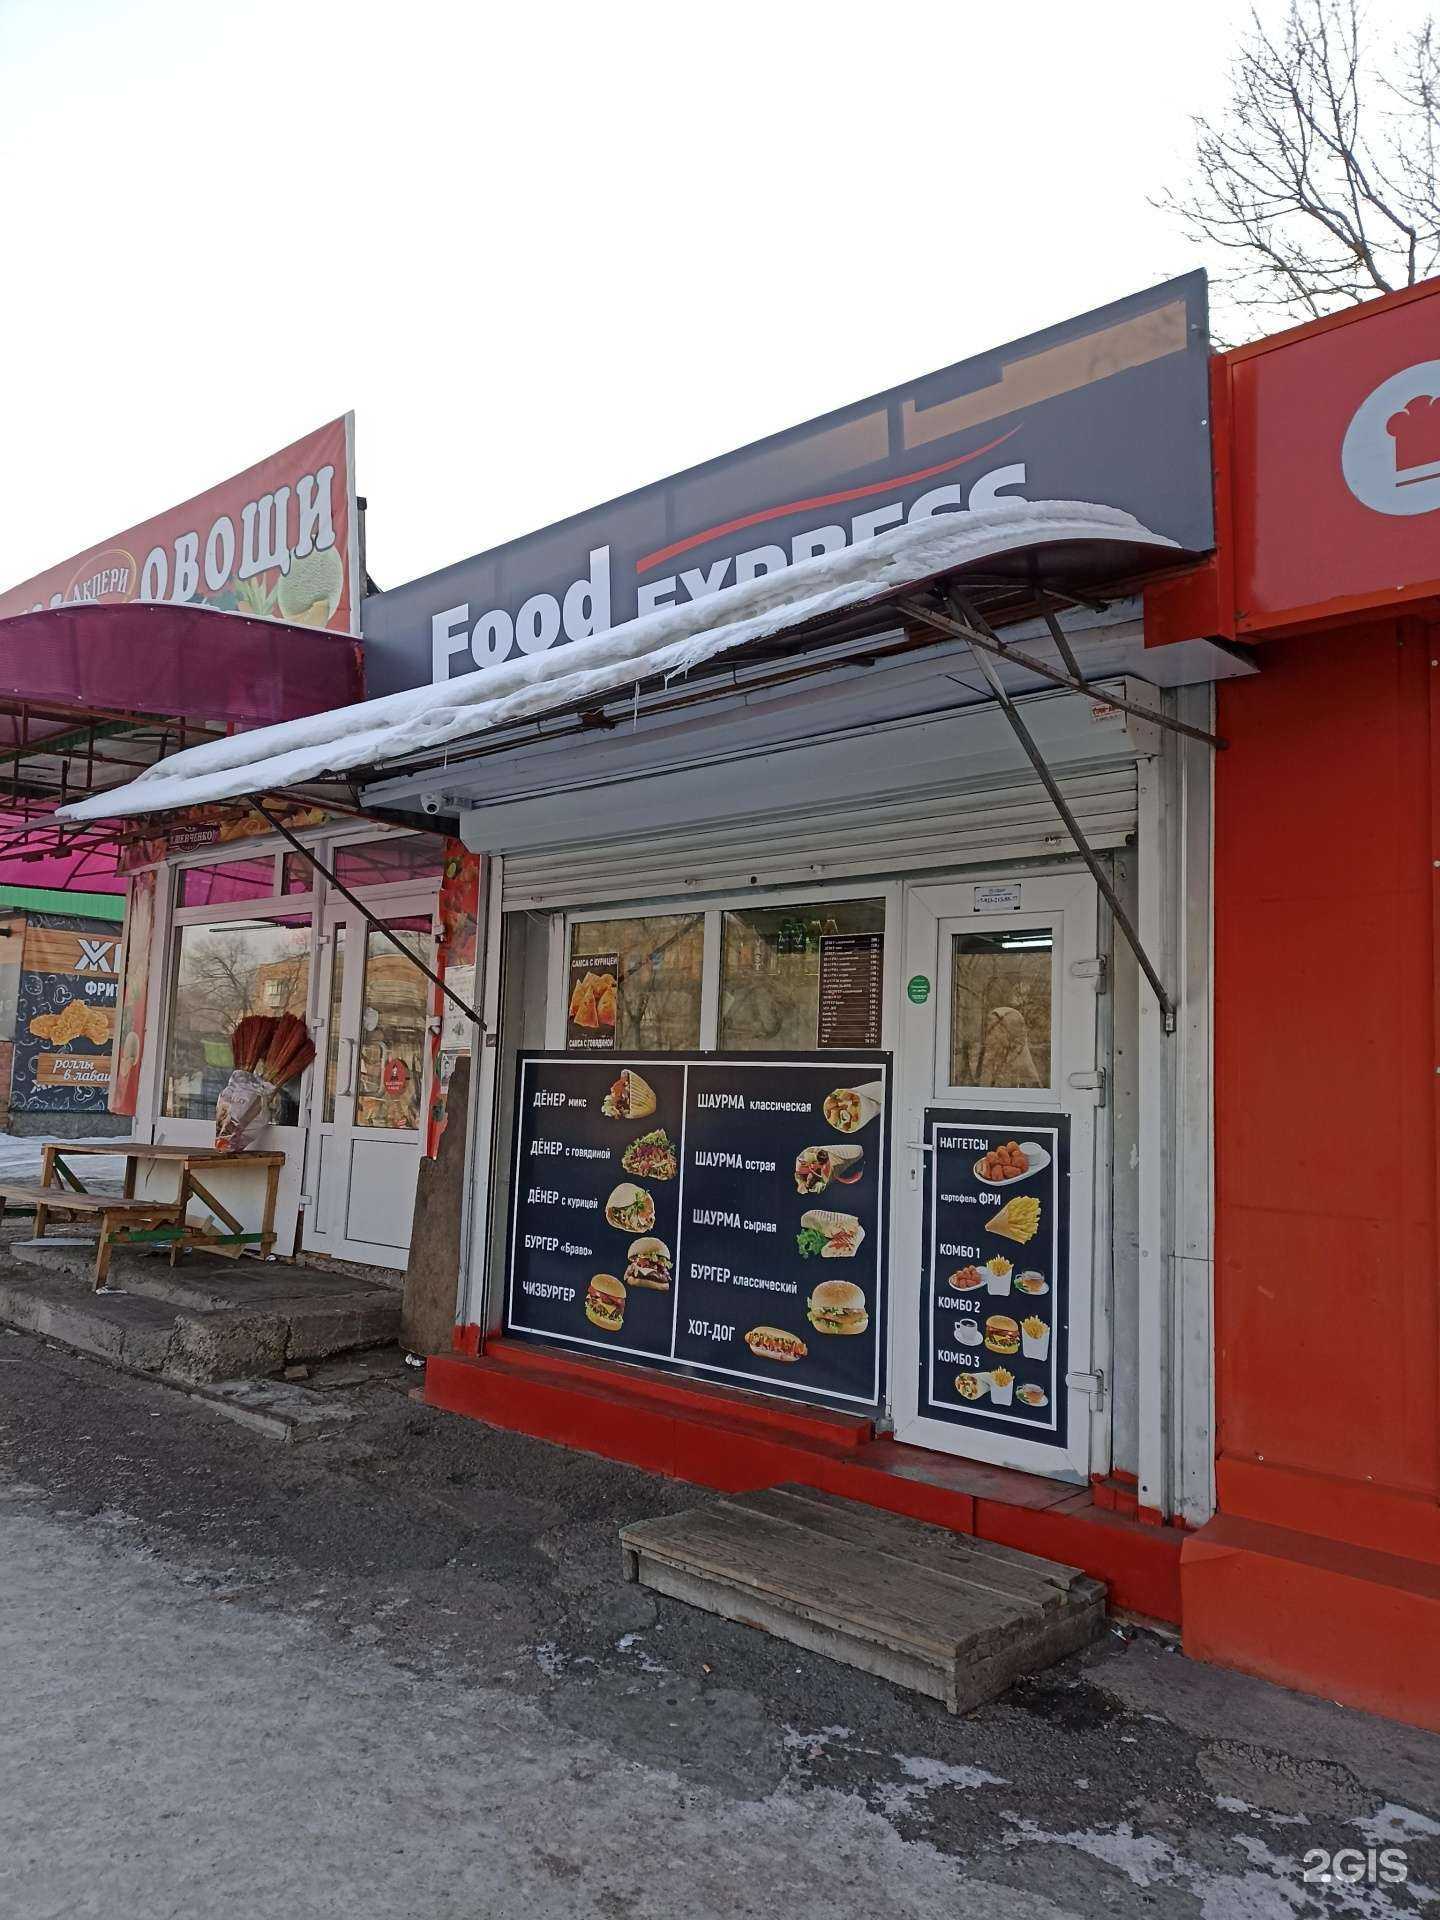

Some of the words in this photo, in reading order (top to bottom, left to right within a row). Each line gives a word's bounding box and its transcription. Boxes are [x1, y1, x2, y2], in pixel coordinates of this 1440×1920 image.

[140, 465, 336, 602] ОВОЩИ
[432, 545, 612, 684] Food
[53, 1058, 94, 1074] роллы
[63, 1069, 73, 1081] в
[533, 1089, 565, 1108] ДЁНЕР
[568, 1097, 587, 1108] микс
[697, 1093, 745, 1110] ШАУРМА
[750, 1100, 812, 1113] классическая
[530, 1138, 563, 1156] ДЁНЕР
[571, 1146, 611, 1160] говядиной
[939, 1136, 989, 1151] НАГГЕТСЫ
[695, 1151, 743, 1169] ШАУРМА
[745, 1160, 776, 1172] острая
[527, 1188, 559, 1204] ДЁНЕР
[567, 1197, 598, 1209] курицей
[940, 1193, 977, 1204] картофель
[978, 1191, 1001, 1206] ФРИ
[693, 1208, 741, 1229] ШАУРМА
[743, 1219, 777, 1233] сырная
[525, 1234, 559, 1253] БУРГЕР
[939, 1243, 974, 1258] КОМБО
[976, 1247, 980, 1259] 1
[690, 1263, 731, 1284] БУРГЕР
[733, 1274, 798, 1294] классический
[522, 1280, 576, 1302] ЧИЗБУРГЕР
[938, 1296, 973, 1312] КОМБО
[974, 1301, 981, 1313] 2
[687, 1318, 736, 1342] ХОТ-ДОГ
[938, 1349, 972, 1366] КОМБО
[973, 1355, 980, 1368] 3
